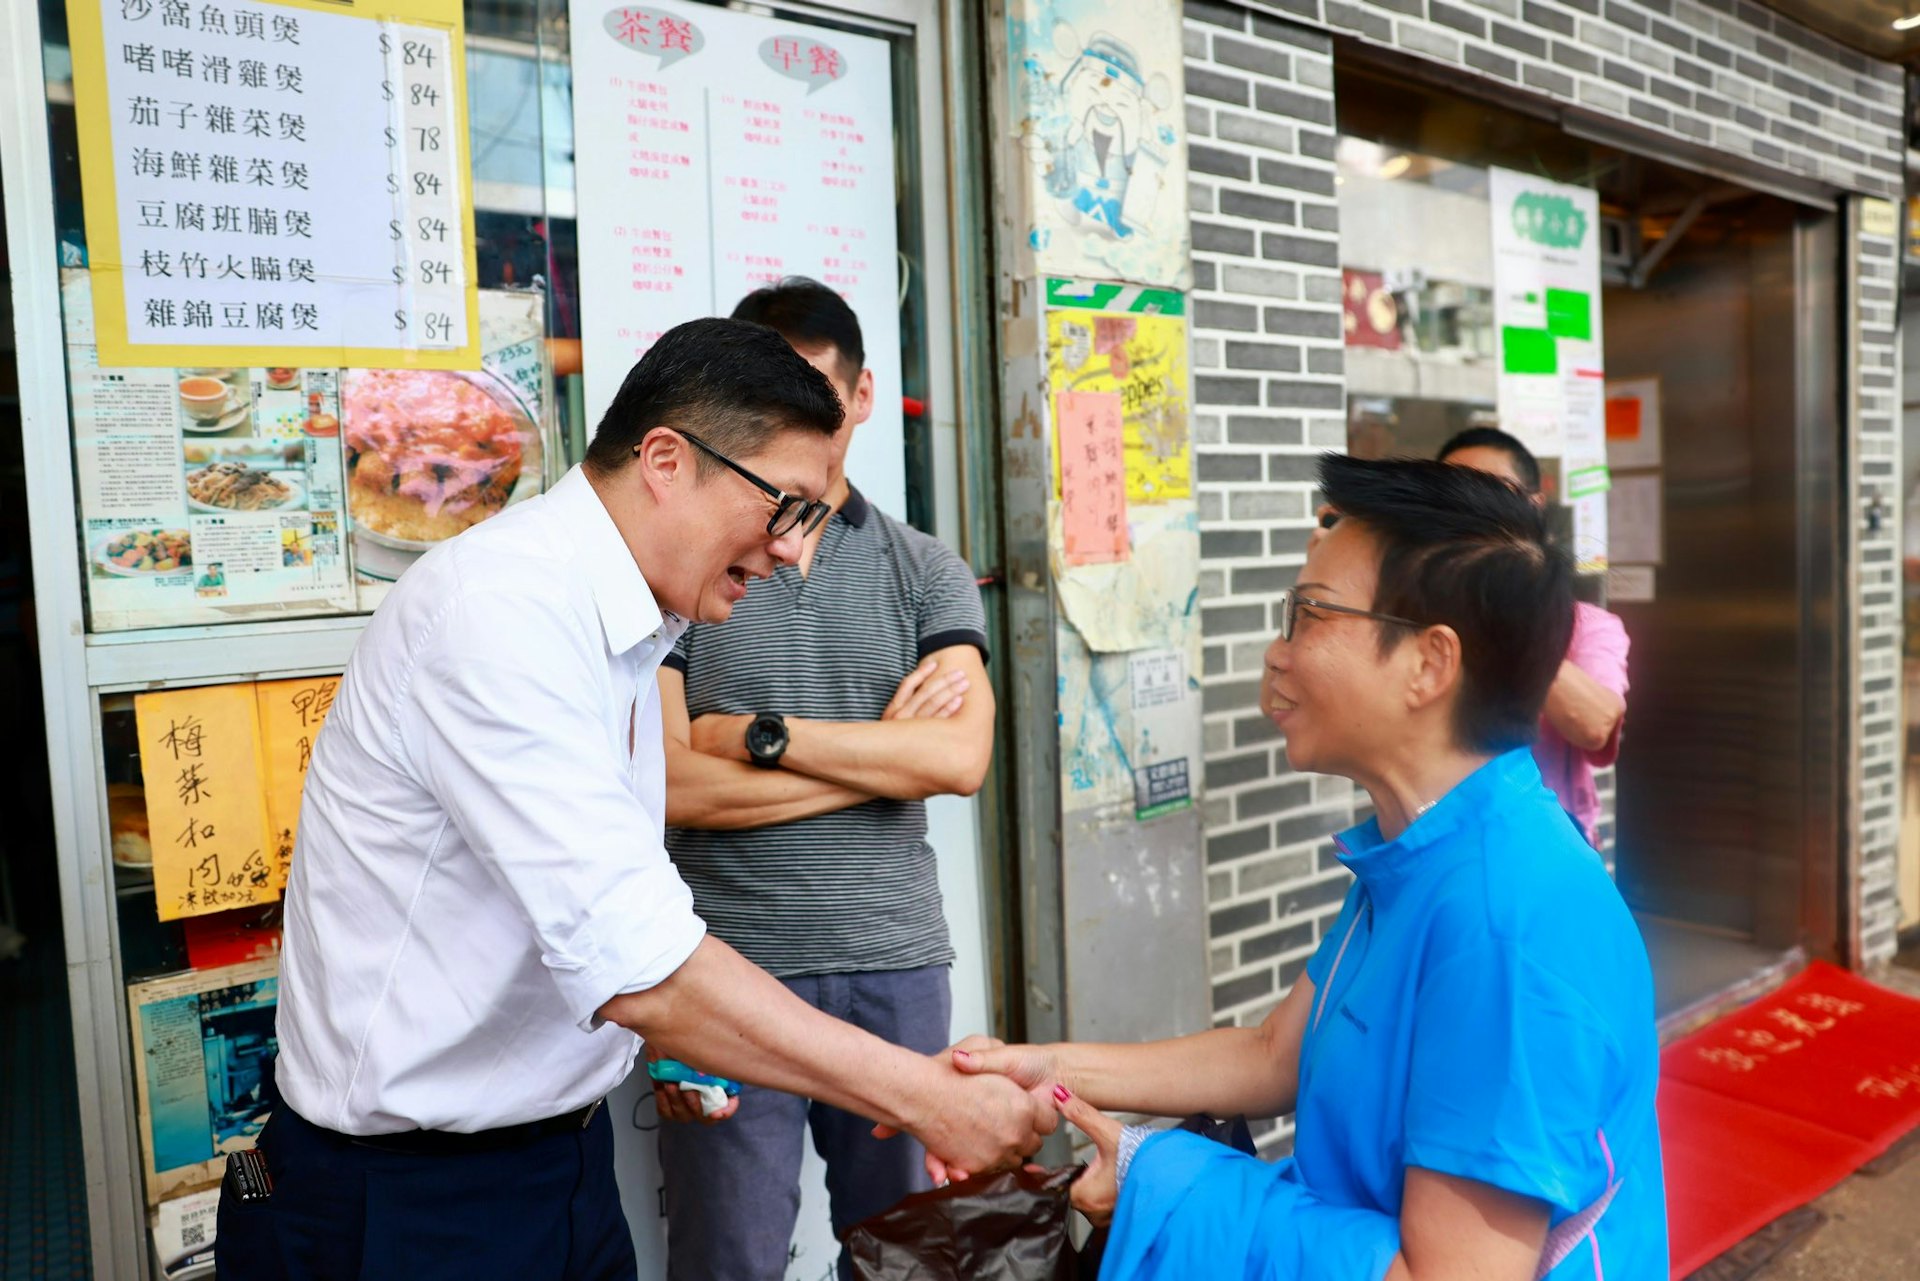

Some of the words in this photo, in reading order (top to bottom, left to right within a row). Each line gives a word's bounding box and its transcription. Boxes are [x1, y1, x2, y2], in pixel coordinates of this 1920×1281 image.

[614, 8, 693, 54] 茶餐
[123, 43, 304, 93] 啫啫滑雞煲
[410, 82, 441, 108] 84
[403, 41, 437, 68] 84
[773, 37, 840, 80] 早餐
[128, 96, 306, 142] 茄子雜菜煲
[412, 126, 442, 152] 78
[132, 147, 309, 190] 海鮮雜菜煲
[413, 171, 443, 196] 84
[137, 199, 312, 239] 豆腐班腩煲
[417, 216, 450, 243] 84
[139, 249, 316, 284] 枝竹火腩煲
[420, 259, 454, 285] 84
[144, 297, 319, 332] 雜錦豆腐煲
[424, 312, 454, 341] 84
